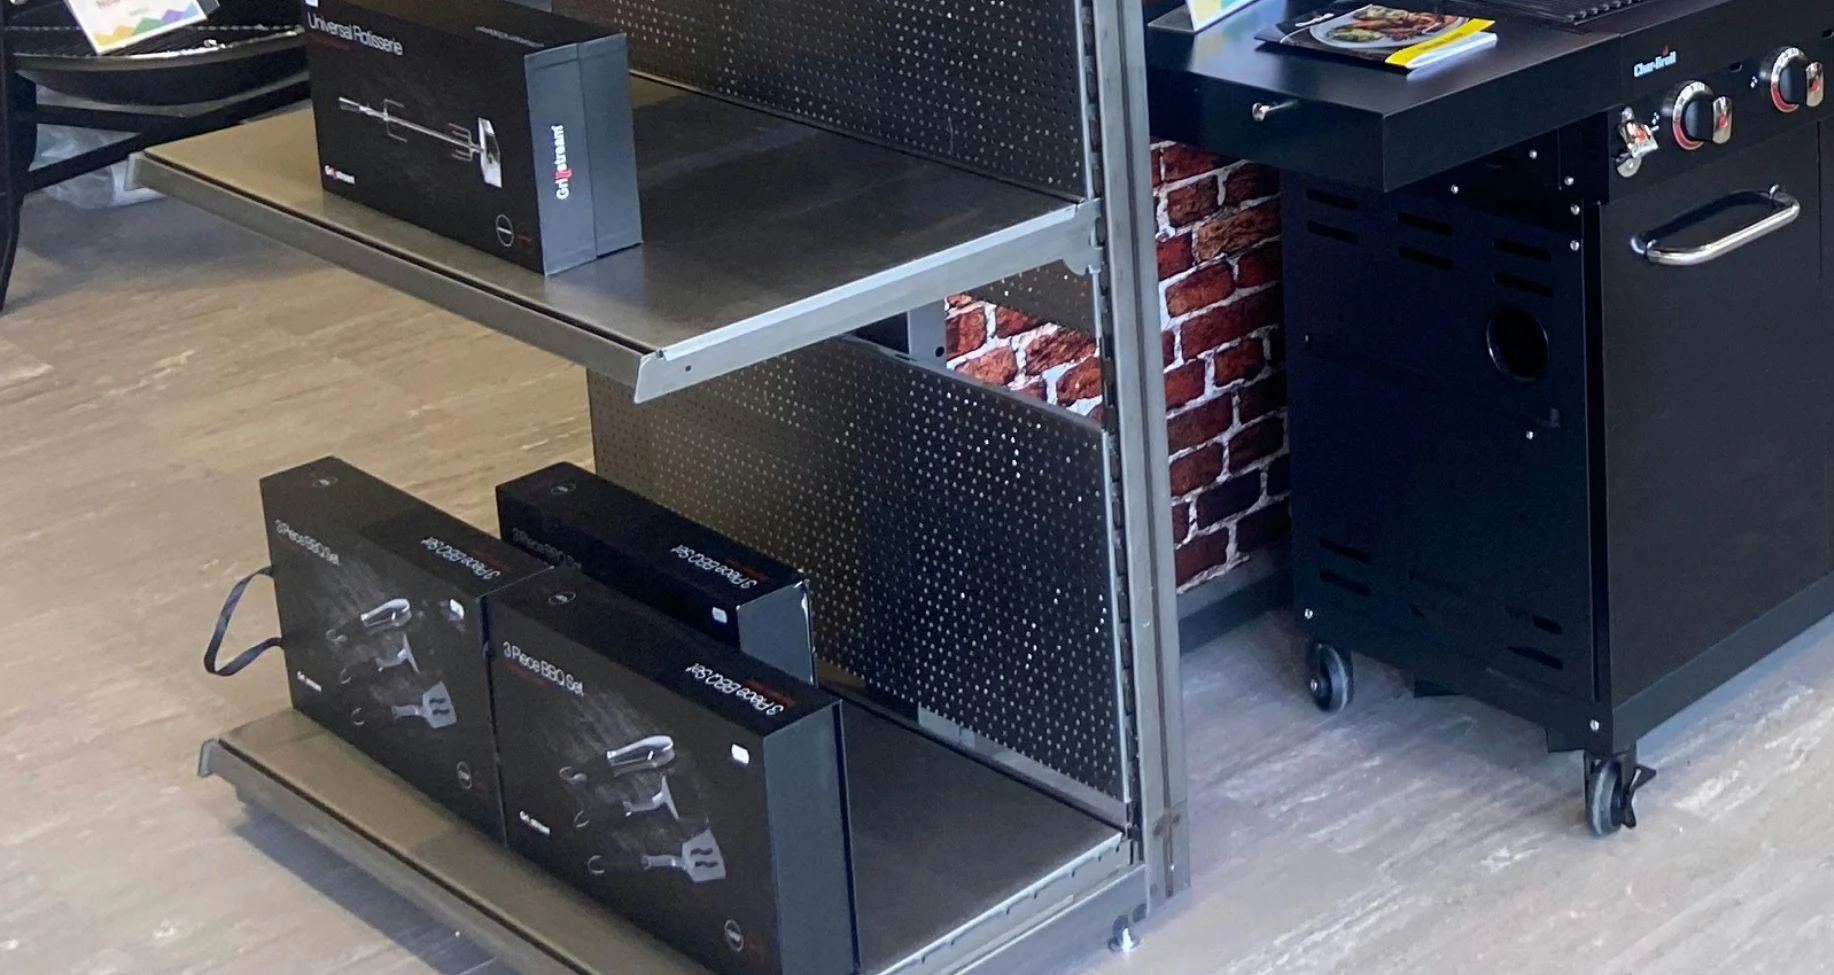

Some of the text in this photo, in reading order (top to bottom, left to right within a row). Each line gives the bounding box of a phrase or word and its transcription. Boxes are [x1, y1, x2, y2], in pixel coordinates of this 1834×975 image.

[307, 11, 353, 41] Universal
[353, 24, 404, 56] Rotisserie
[541, 659, 565, 686] BBQ
[566, 673, 584, 697] Set
[705, 670, 740, 695] BBQ
